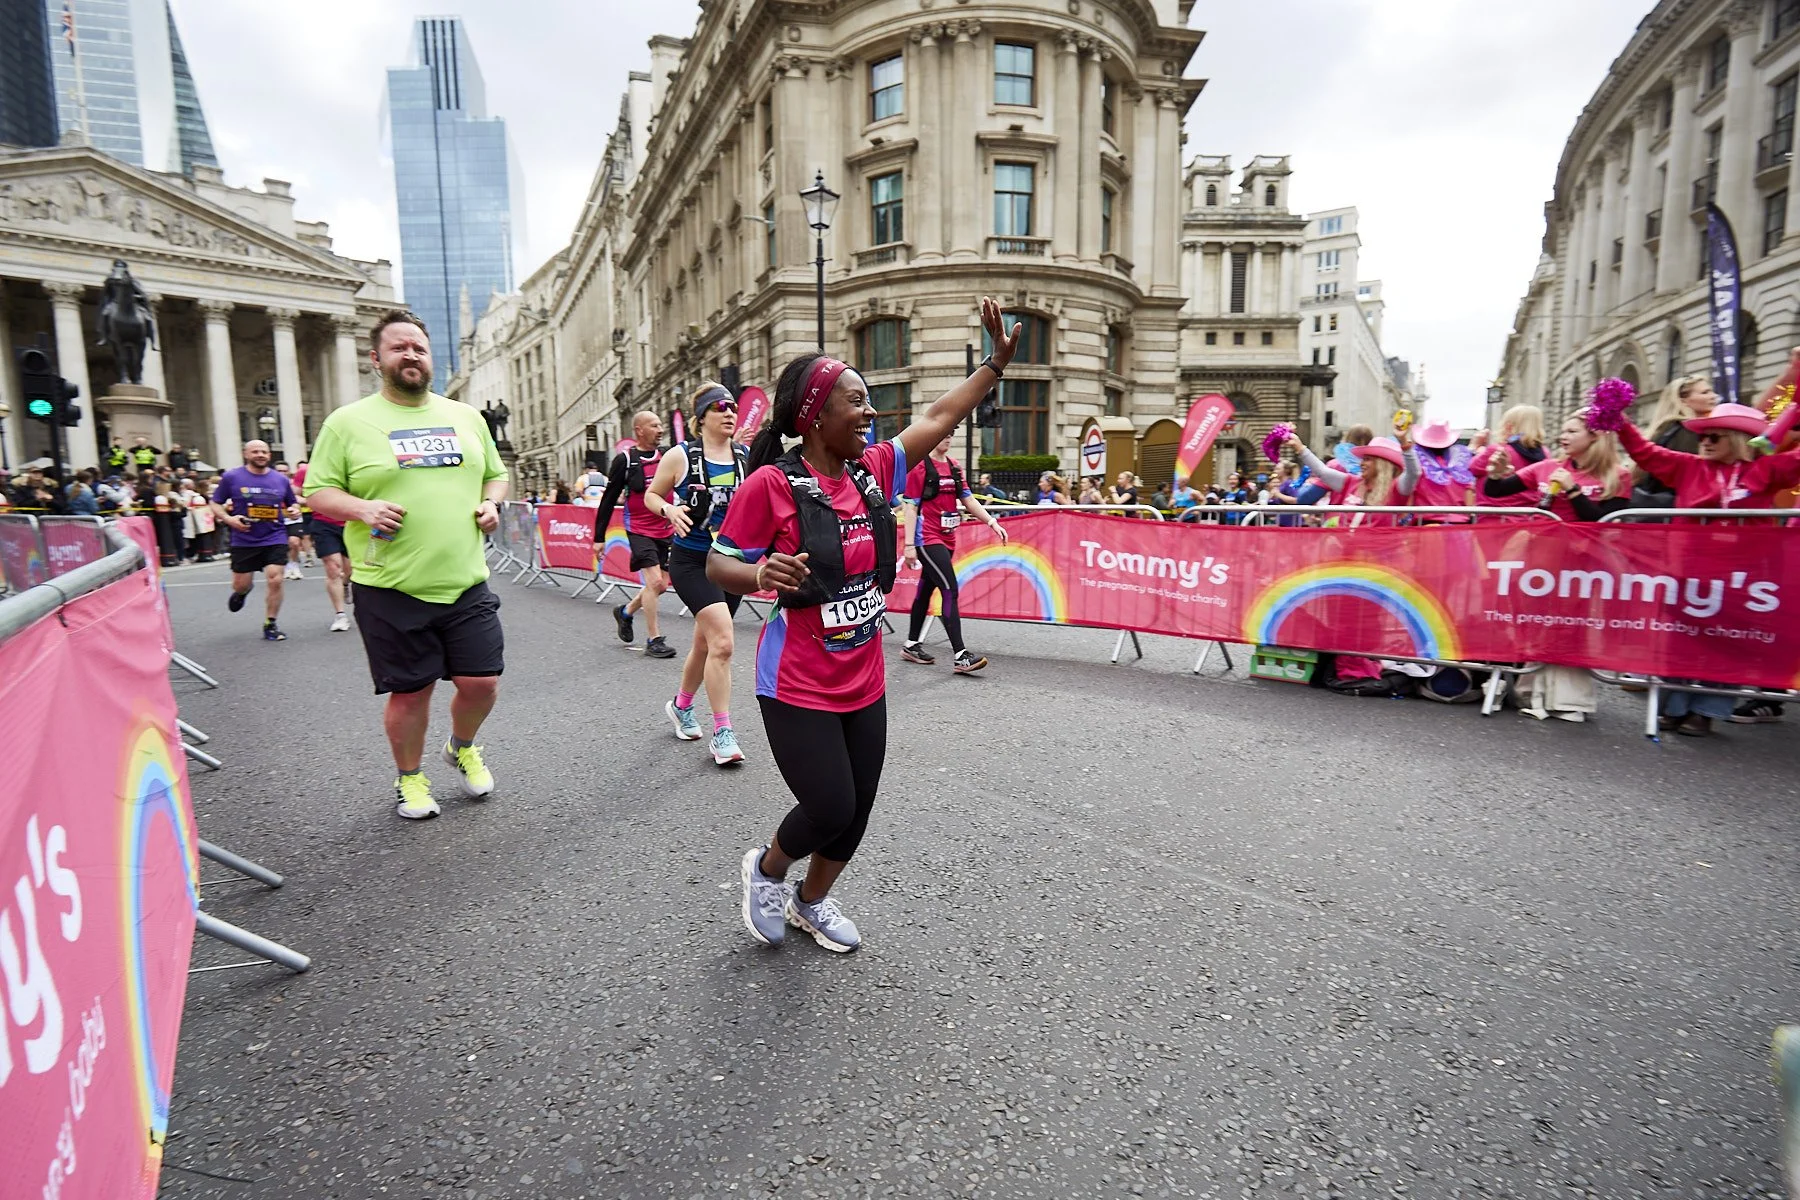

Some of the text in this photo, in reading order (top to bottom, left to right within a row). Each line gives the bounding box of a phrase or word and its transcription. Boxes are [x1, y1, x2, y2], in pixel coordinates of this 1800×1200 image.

[799, 387, 820, 419] TALA
[397, 438, 455, 453] 11231
[1184, 405, 1220, 451] Tommy's
[1079, 540, 1230, 589] Tommy's
[1079, 577, 1229, 608] The pregnancy and baby charity
[1486, 560, 1781, 618] Tommy's
[1483, 610, 1777, 644] The pregnancy and baby charity
[0, 813, 82, 1089] y's
